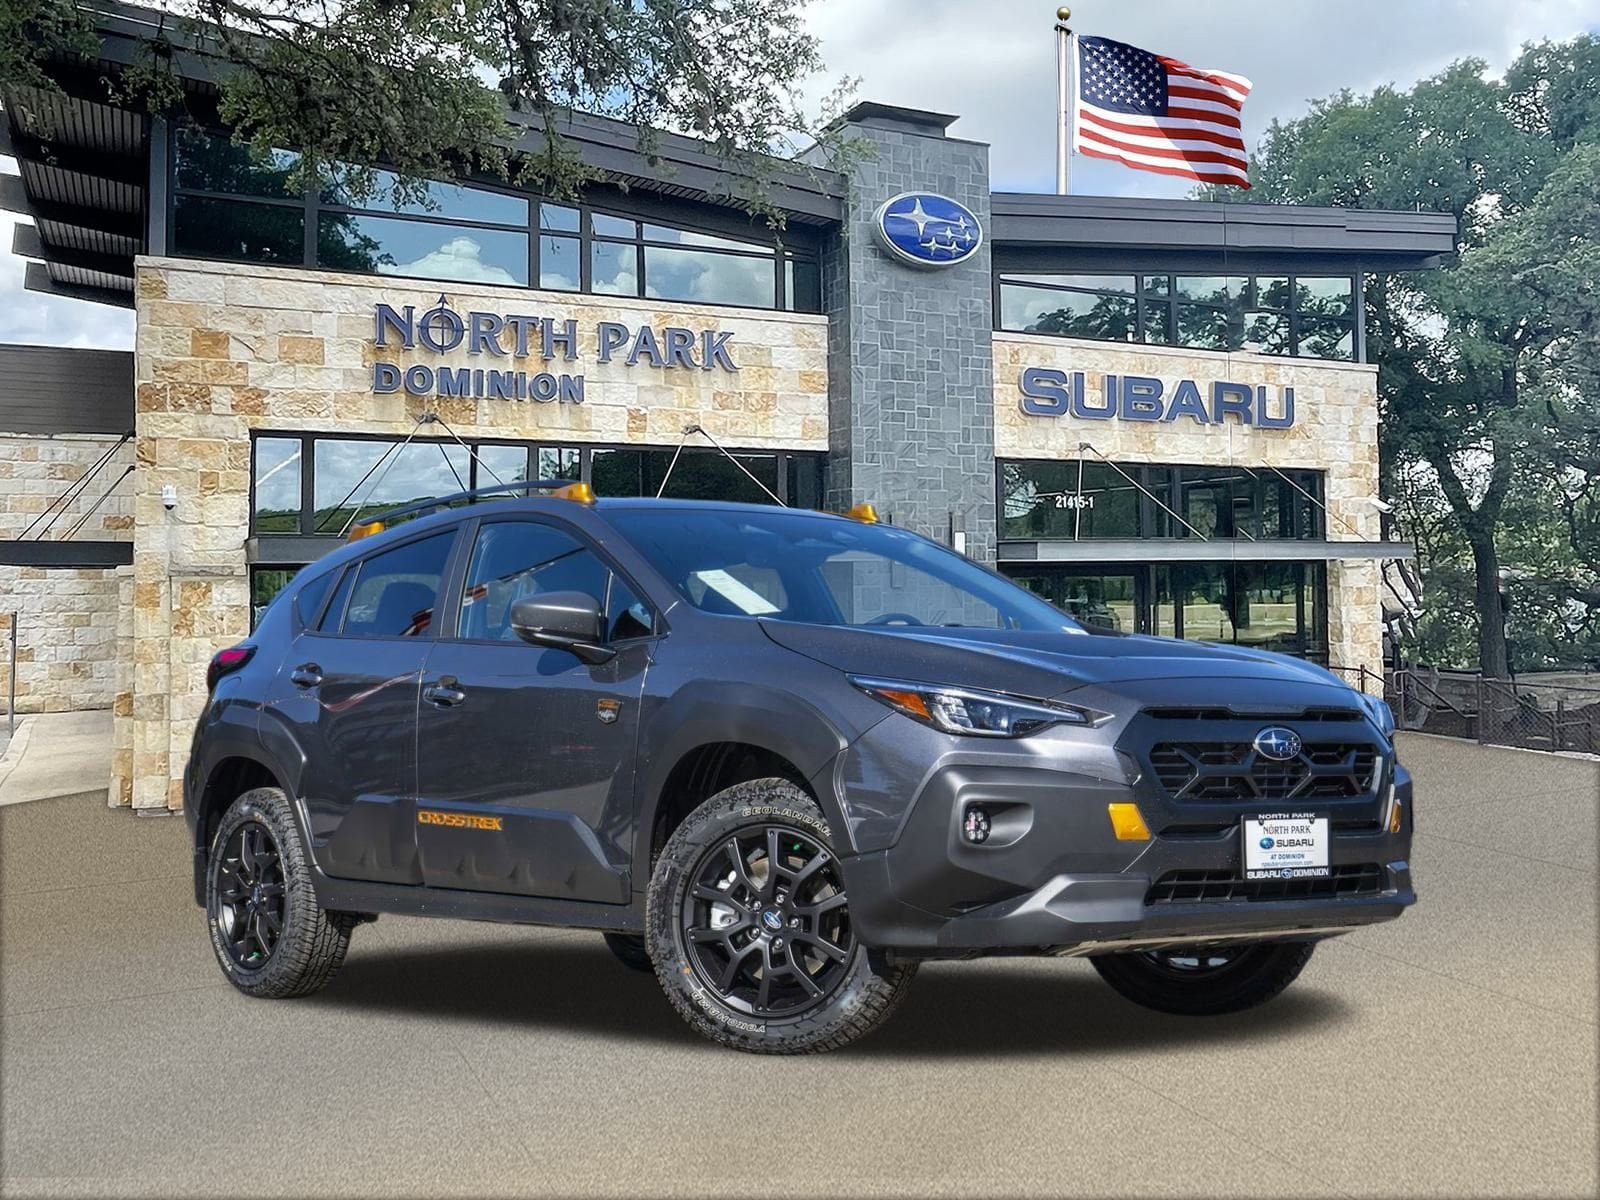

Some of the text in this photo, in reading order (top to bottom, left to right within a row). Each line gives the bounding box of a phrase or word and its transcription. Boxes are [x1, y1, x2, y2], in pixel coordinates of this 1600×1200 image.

[374, 301, 742, 373] NORTH PARK
[371, 361, 585, 404] DOMINION
[1018, 366, 1295, 430] SUBARU
[417, 809, 503, 831] CROSSTREK
[1263, 824, 1312, 835] NORTH PARK
[1276, 838, 1315, 848] SUBARU
[1247, 867, 1329, 879] SUBARU DOMINION
[691, 991, 766, 1033] YOKOHAMA
